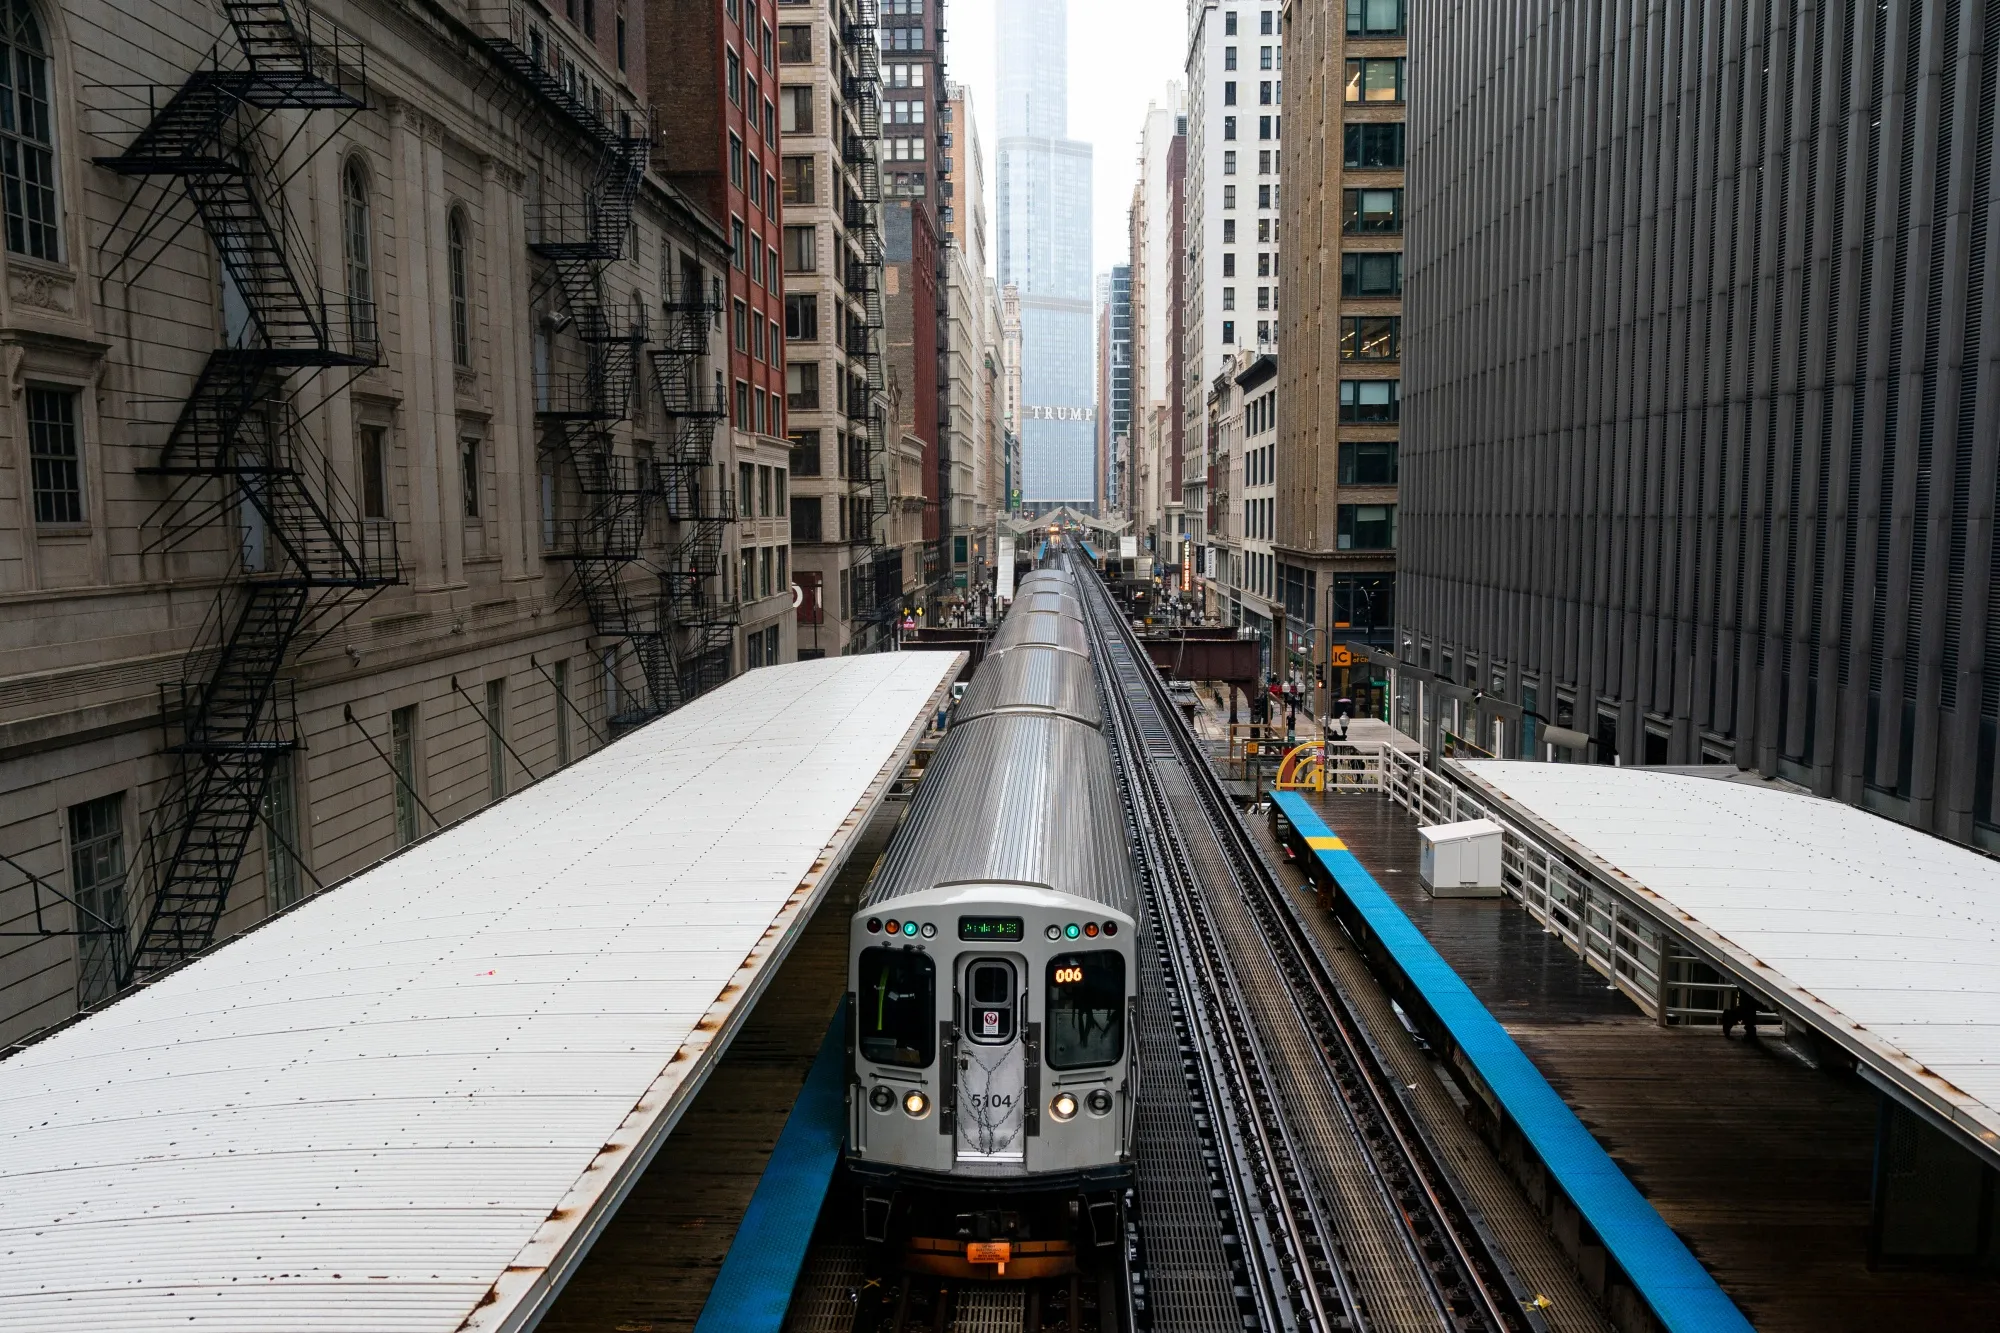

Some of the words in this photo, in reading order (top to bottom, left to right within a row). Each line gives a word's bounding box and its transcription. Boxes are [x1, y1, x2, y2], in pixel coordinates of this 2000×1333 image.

[1032, 406, 1093, 421] TRUMP
[1332, 651, 1348, 663] IC
[1055, 967, 1082, 983] 006
[971, 1094, 1012, 1108] 5104
